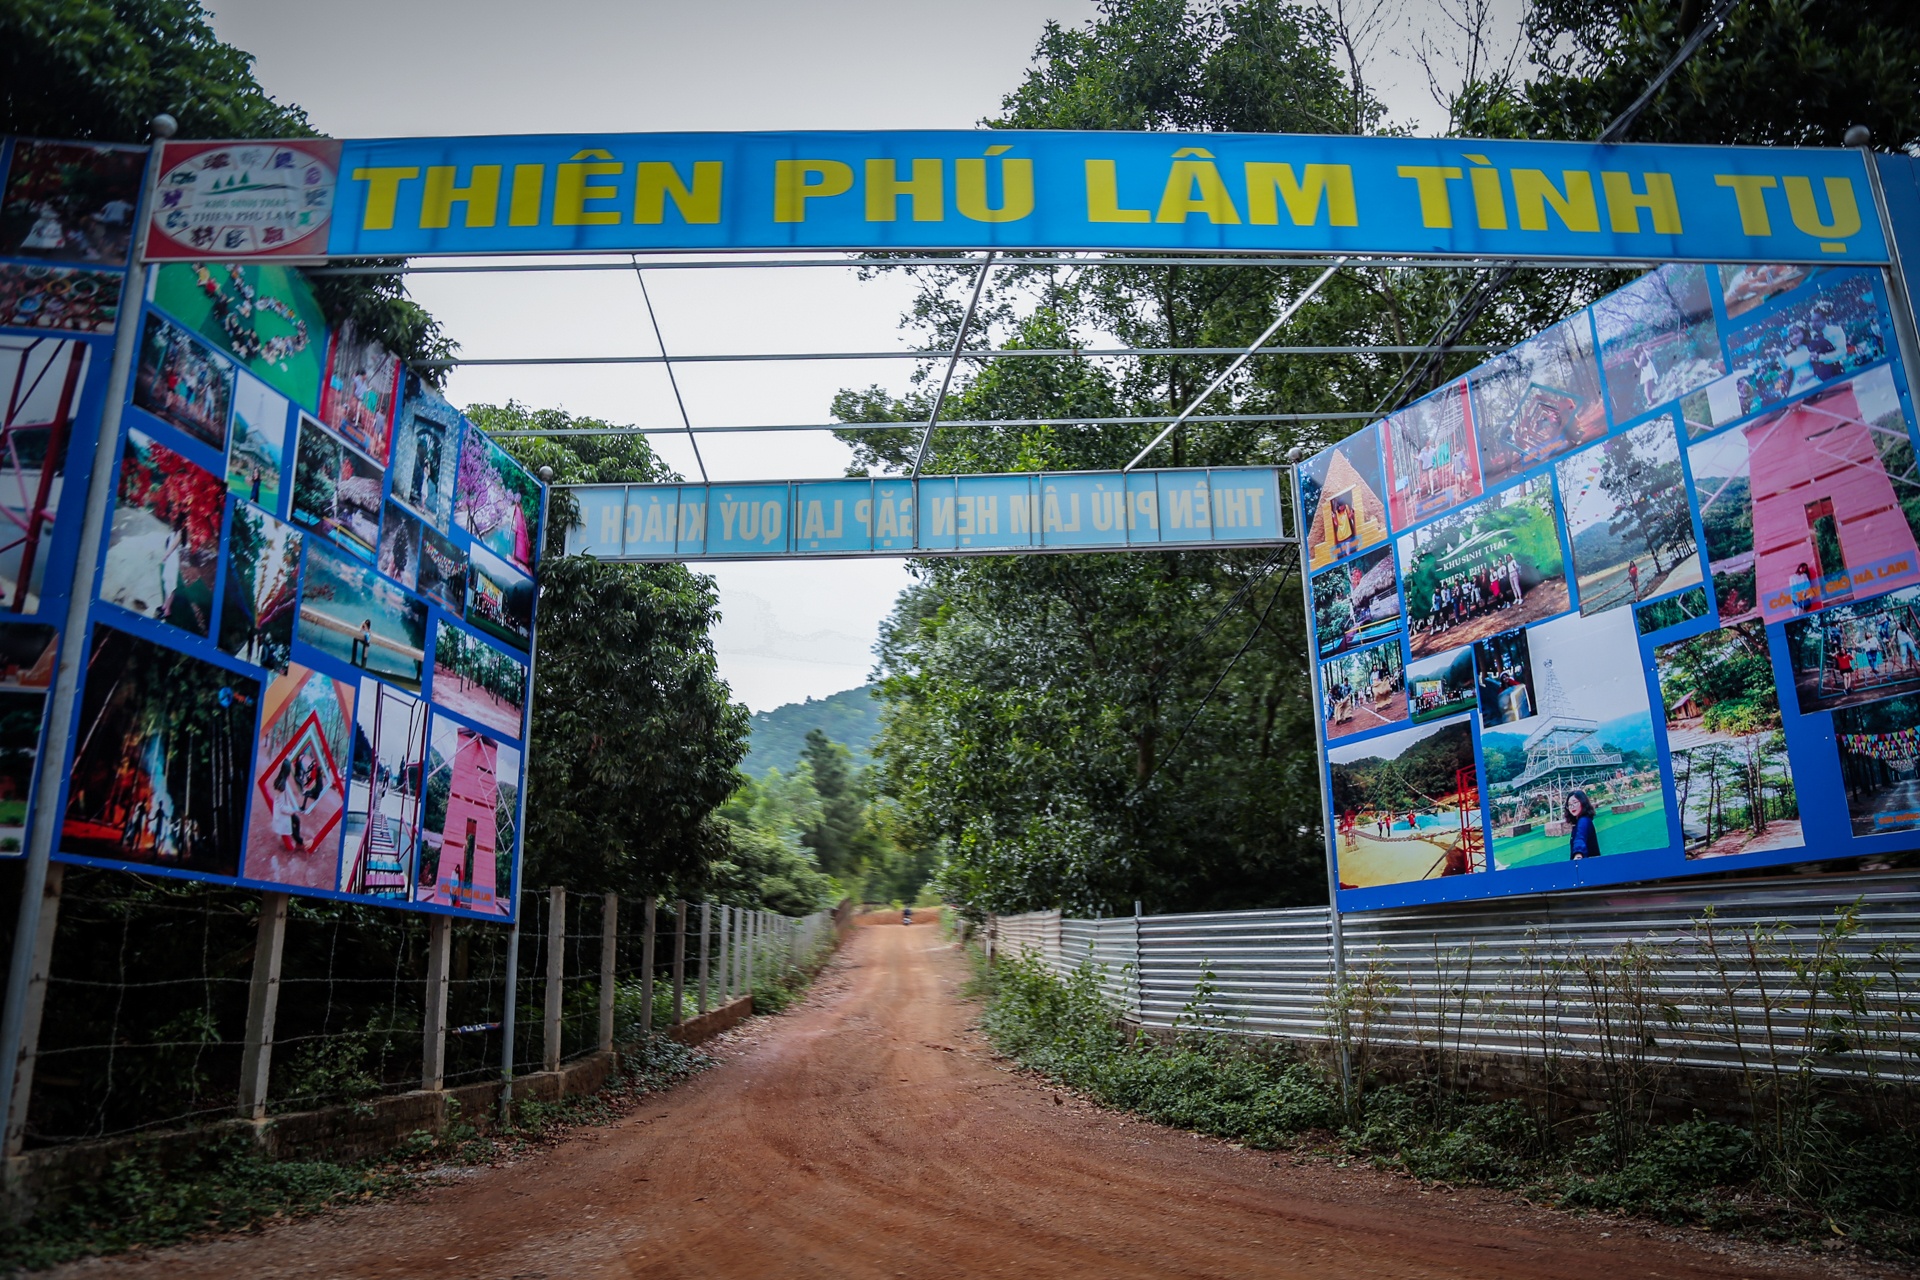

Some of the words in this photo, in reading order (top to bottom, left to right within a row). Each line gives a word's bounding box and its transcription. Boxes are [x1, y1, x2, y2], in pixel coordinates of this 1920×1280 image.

[352, 149, 723, 230] THIÊN
[774, 145, 1035, 223] PHÚ
[1085, 147, 1359, 227] LÂM
[1397, 154, 1684, 235] TÌNH
[1714, 174, 1862, 253] TỤ
[1443, 560, 1461, 571] KHU
[1461, 549, 1482, 564] SINH
[1484, 539, 1508, 554] THAI
[1877, 560, 1909, 578] LAN
